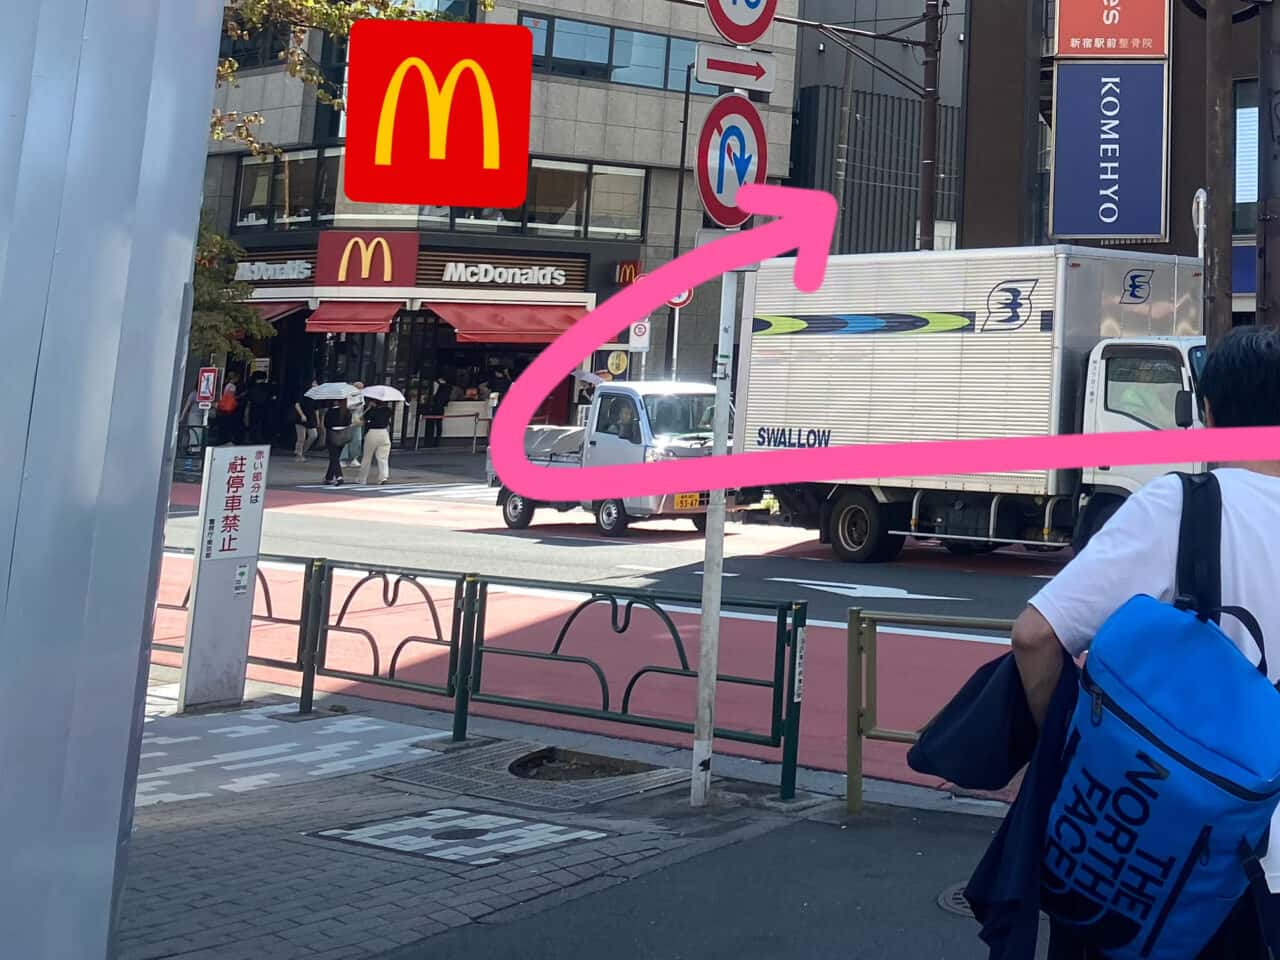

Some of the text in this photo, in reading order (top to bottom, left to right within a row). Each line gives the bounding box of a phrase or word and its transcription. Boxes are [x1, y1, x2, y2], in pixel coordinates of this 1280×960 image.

[1099, 76, 1120, 224] KOMEHYO
[443, 262, 566, 285] McDonald's
[249, 450, 265, 505] 赤い部分は
[757, 426, 831, 449] SWALLOW
[218, 455, 247, 553] 駐停車禁止
[1050, 766, 1112, 880] FACE
[1072, 749, 1171, 903] NORTH
[1111, 848, 1176, 920] THE
